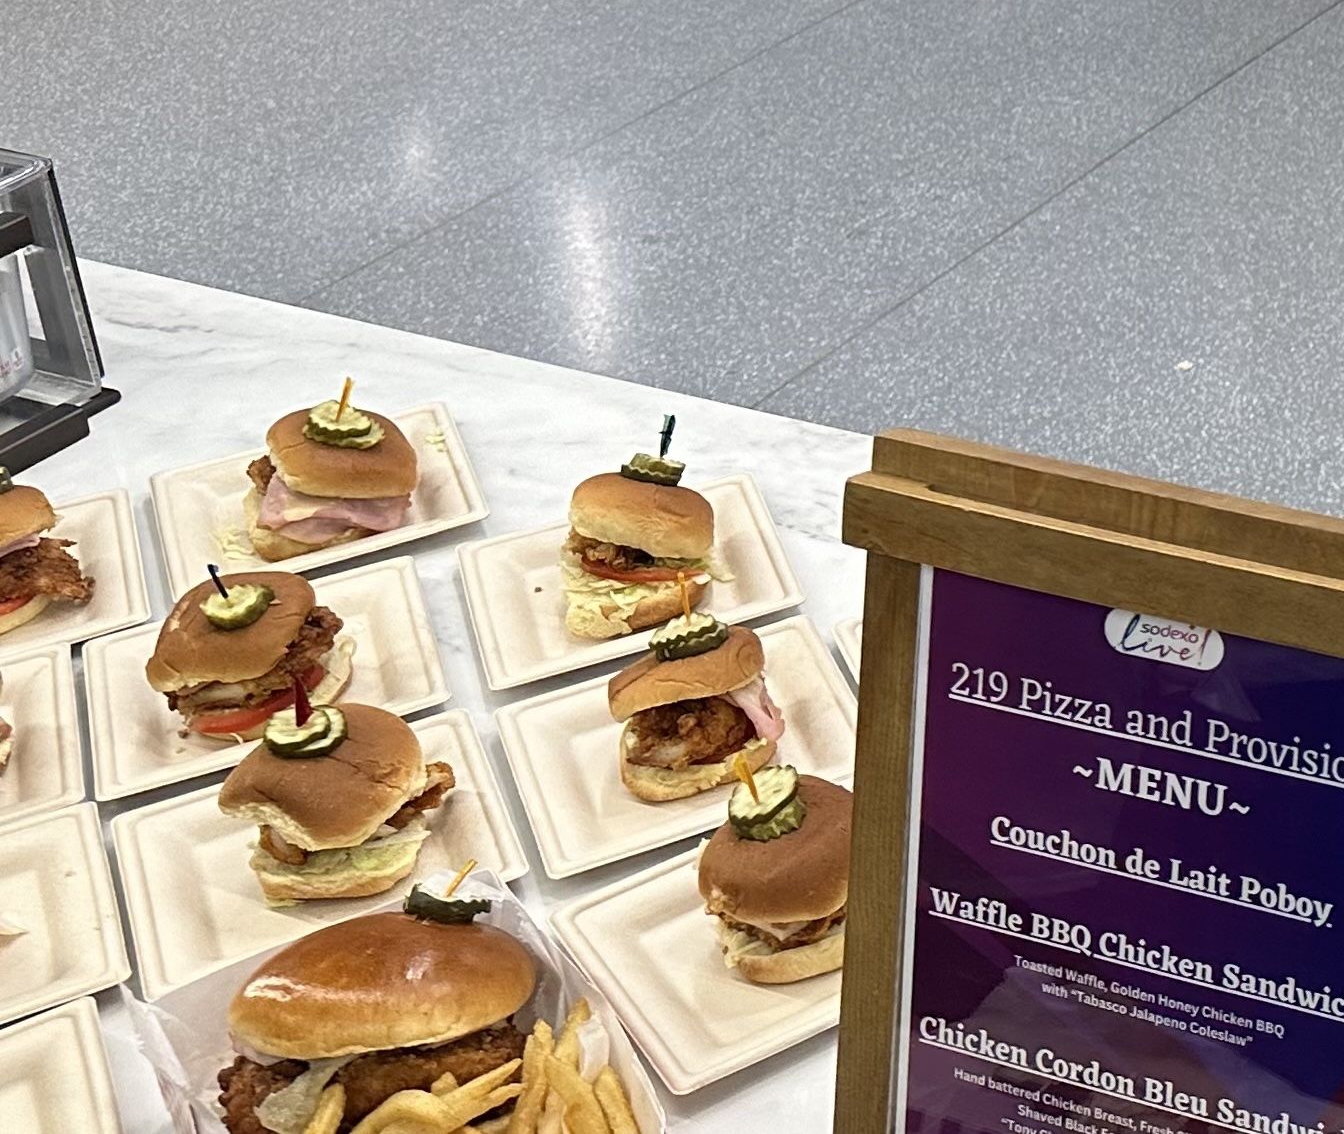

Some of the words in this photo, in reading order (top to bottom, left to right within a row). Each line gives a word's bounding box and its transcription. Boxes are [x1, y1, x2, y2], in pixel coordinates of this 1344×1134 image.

[1140, 622, 1199, 644] sodexo
[950, 662, 1009, 703] 219
[1019, 677, 1113, 730] Pizza
[1126, 709, 1194, 747] and
[990, 816, 1118, 870] Couchon
[1125, 847, 1161, 879] de
[1168, 857, 1232, 896] Lait
[1239, 875, 1334, 928] Poboy
[929, 886, 1024, 932] Waffle
[1030, 912, 1092, 957] BBQ
[1098, 932, 1215, 984] Chicken
[1013, 954, 1063, 979] Toasted
[1065, 968, 1109, 993] Waffle,
[1110, 981, 1156, 1004] Golden
[1158, 993, 1200, 1017] Honey
[1201, 1005, 1254, 1030] Chicken
[1255, 1018, 1286, 1040] BBQ
[1041, 982, 1069, 1000] with
[1129, 1005, 1188, 1031] Jalapeno
[919, 1016, 1029, 1067] Chicken
[1035, 1048, 1136, 1098] Cordon
[1143, 1077, 1209, 1117] Bleu
[953, 1067, 986, 1086] Hand
[988, 1076, 1041, 1103] battered
[1042, 1092, 1092, 1117] Chicken
[1094, 1107, 1138, 1132] Breast,
[1017, 1104, 1063, 1127] Shaved
